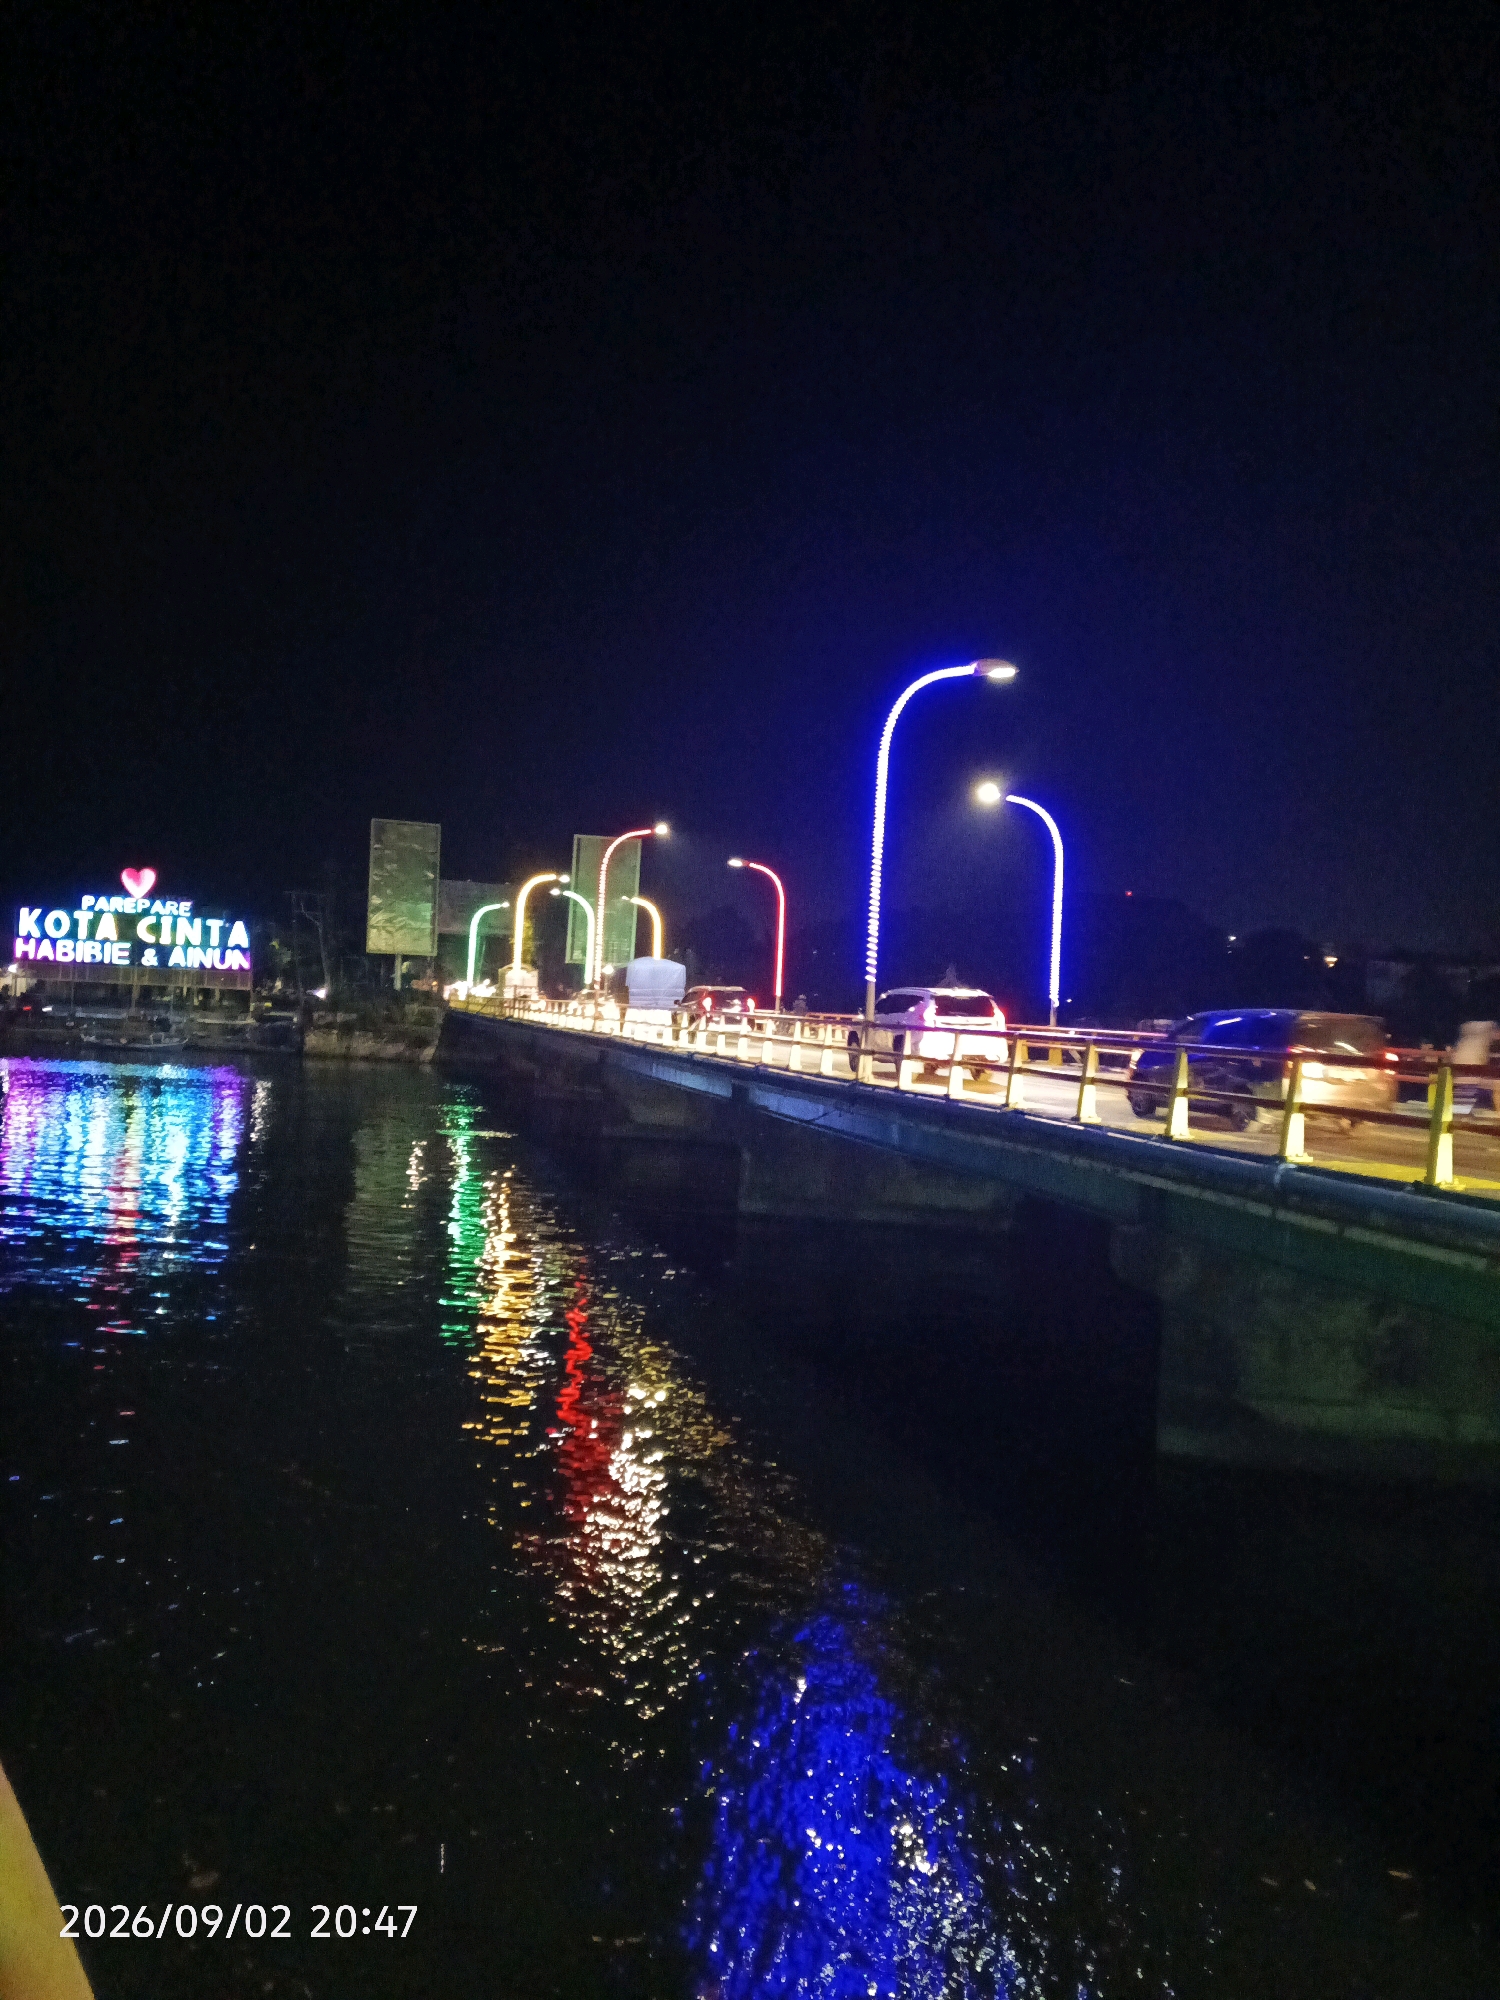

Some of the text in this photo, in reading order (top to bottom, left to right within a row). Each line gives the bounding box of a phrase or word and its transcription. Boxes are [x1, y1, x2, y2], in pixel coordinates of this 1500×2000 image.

[81, 894, 192, 917] PAREPARE
[18, 907, 249, 948] KOTA CINTA
[15, 937, 250, 970] HABIBIE & AINUN
